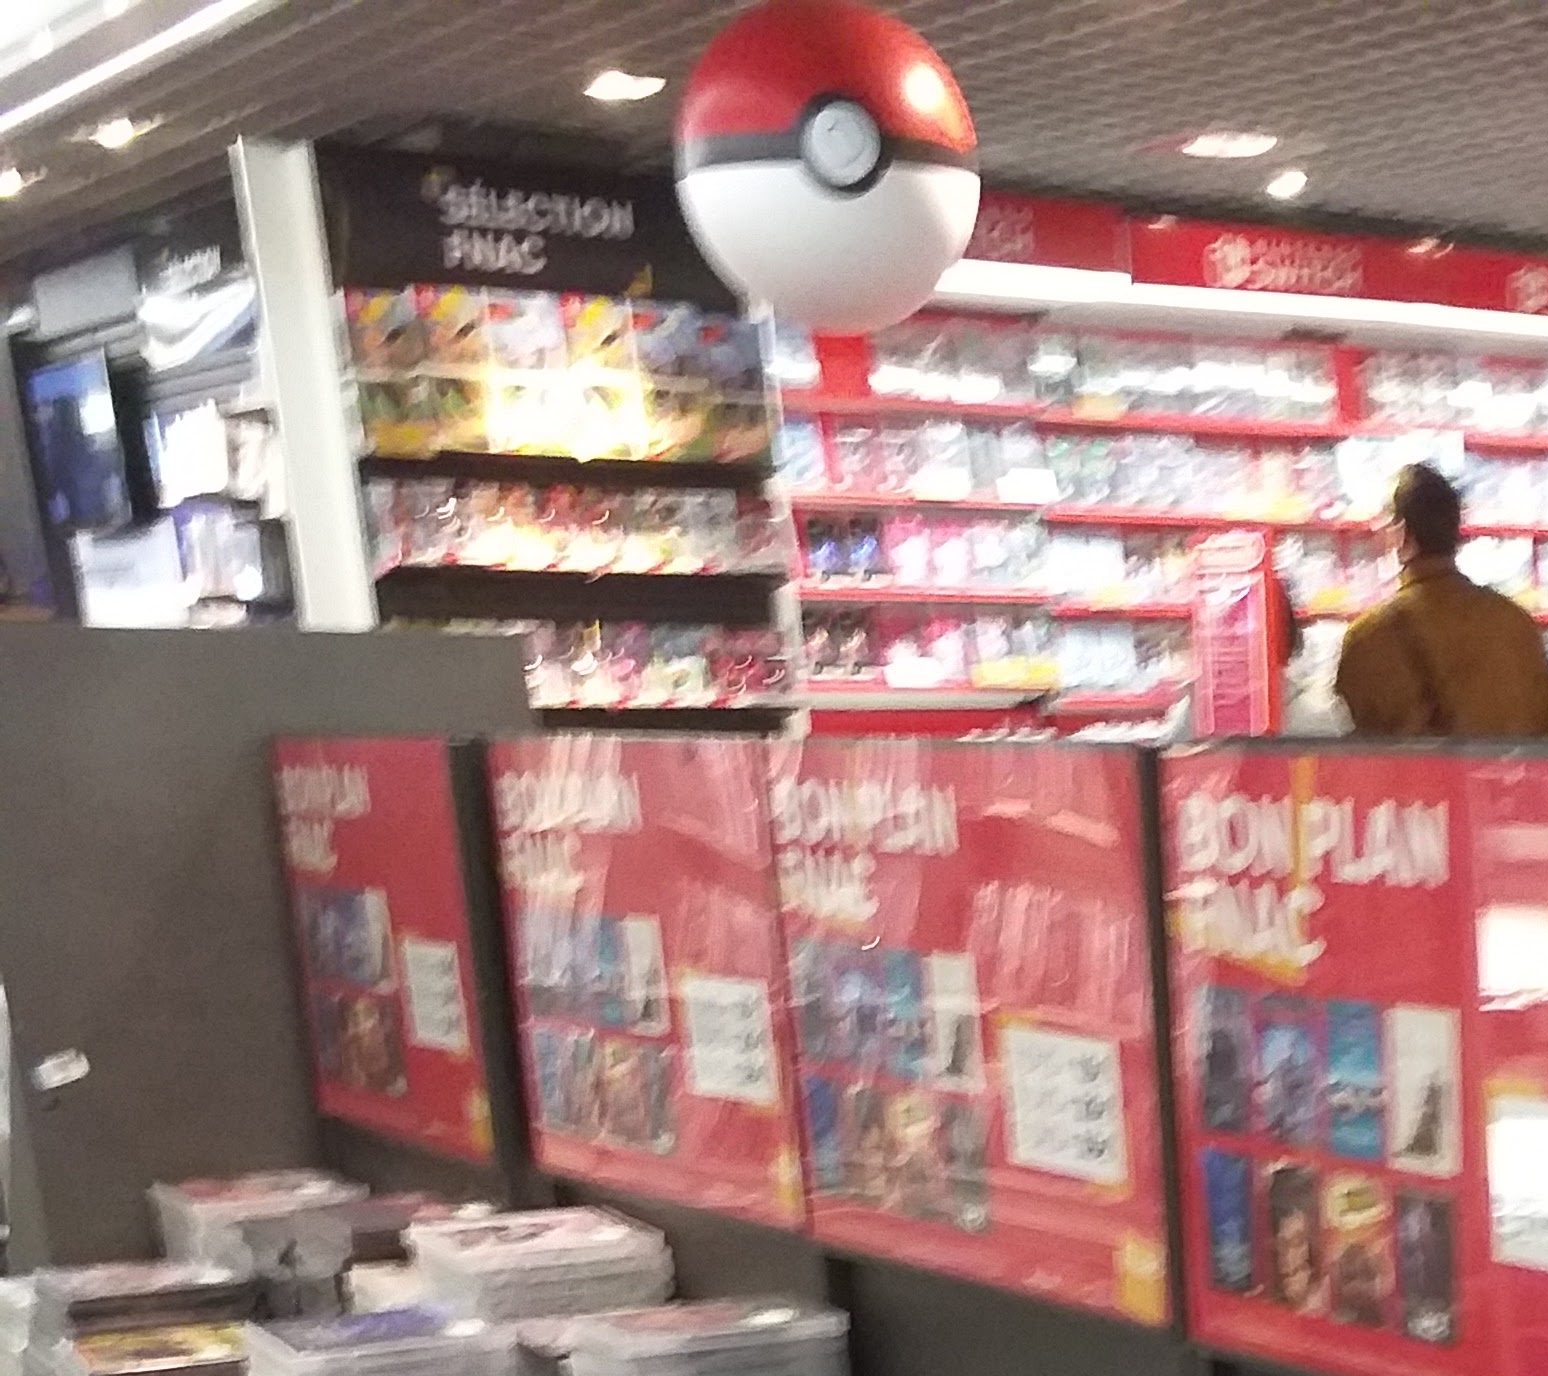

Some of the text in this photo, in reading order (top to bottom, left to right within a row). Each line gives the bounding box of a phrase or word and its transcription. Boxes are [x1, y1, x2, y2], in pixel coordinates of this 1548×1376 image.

[443, 229, 548, 274] FNAC
[1178, 790, 1452, 889] BON PLAN
[1176, 876, 1328, 968] FNAC
